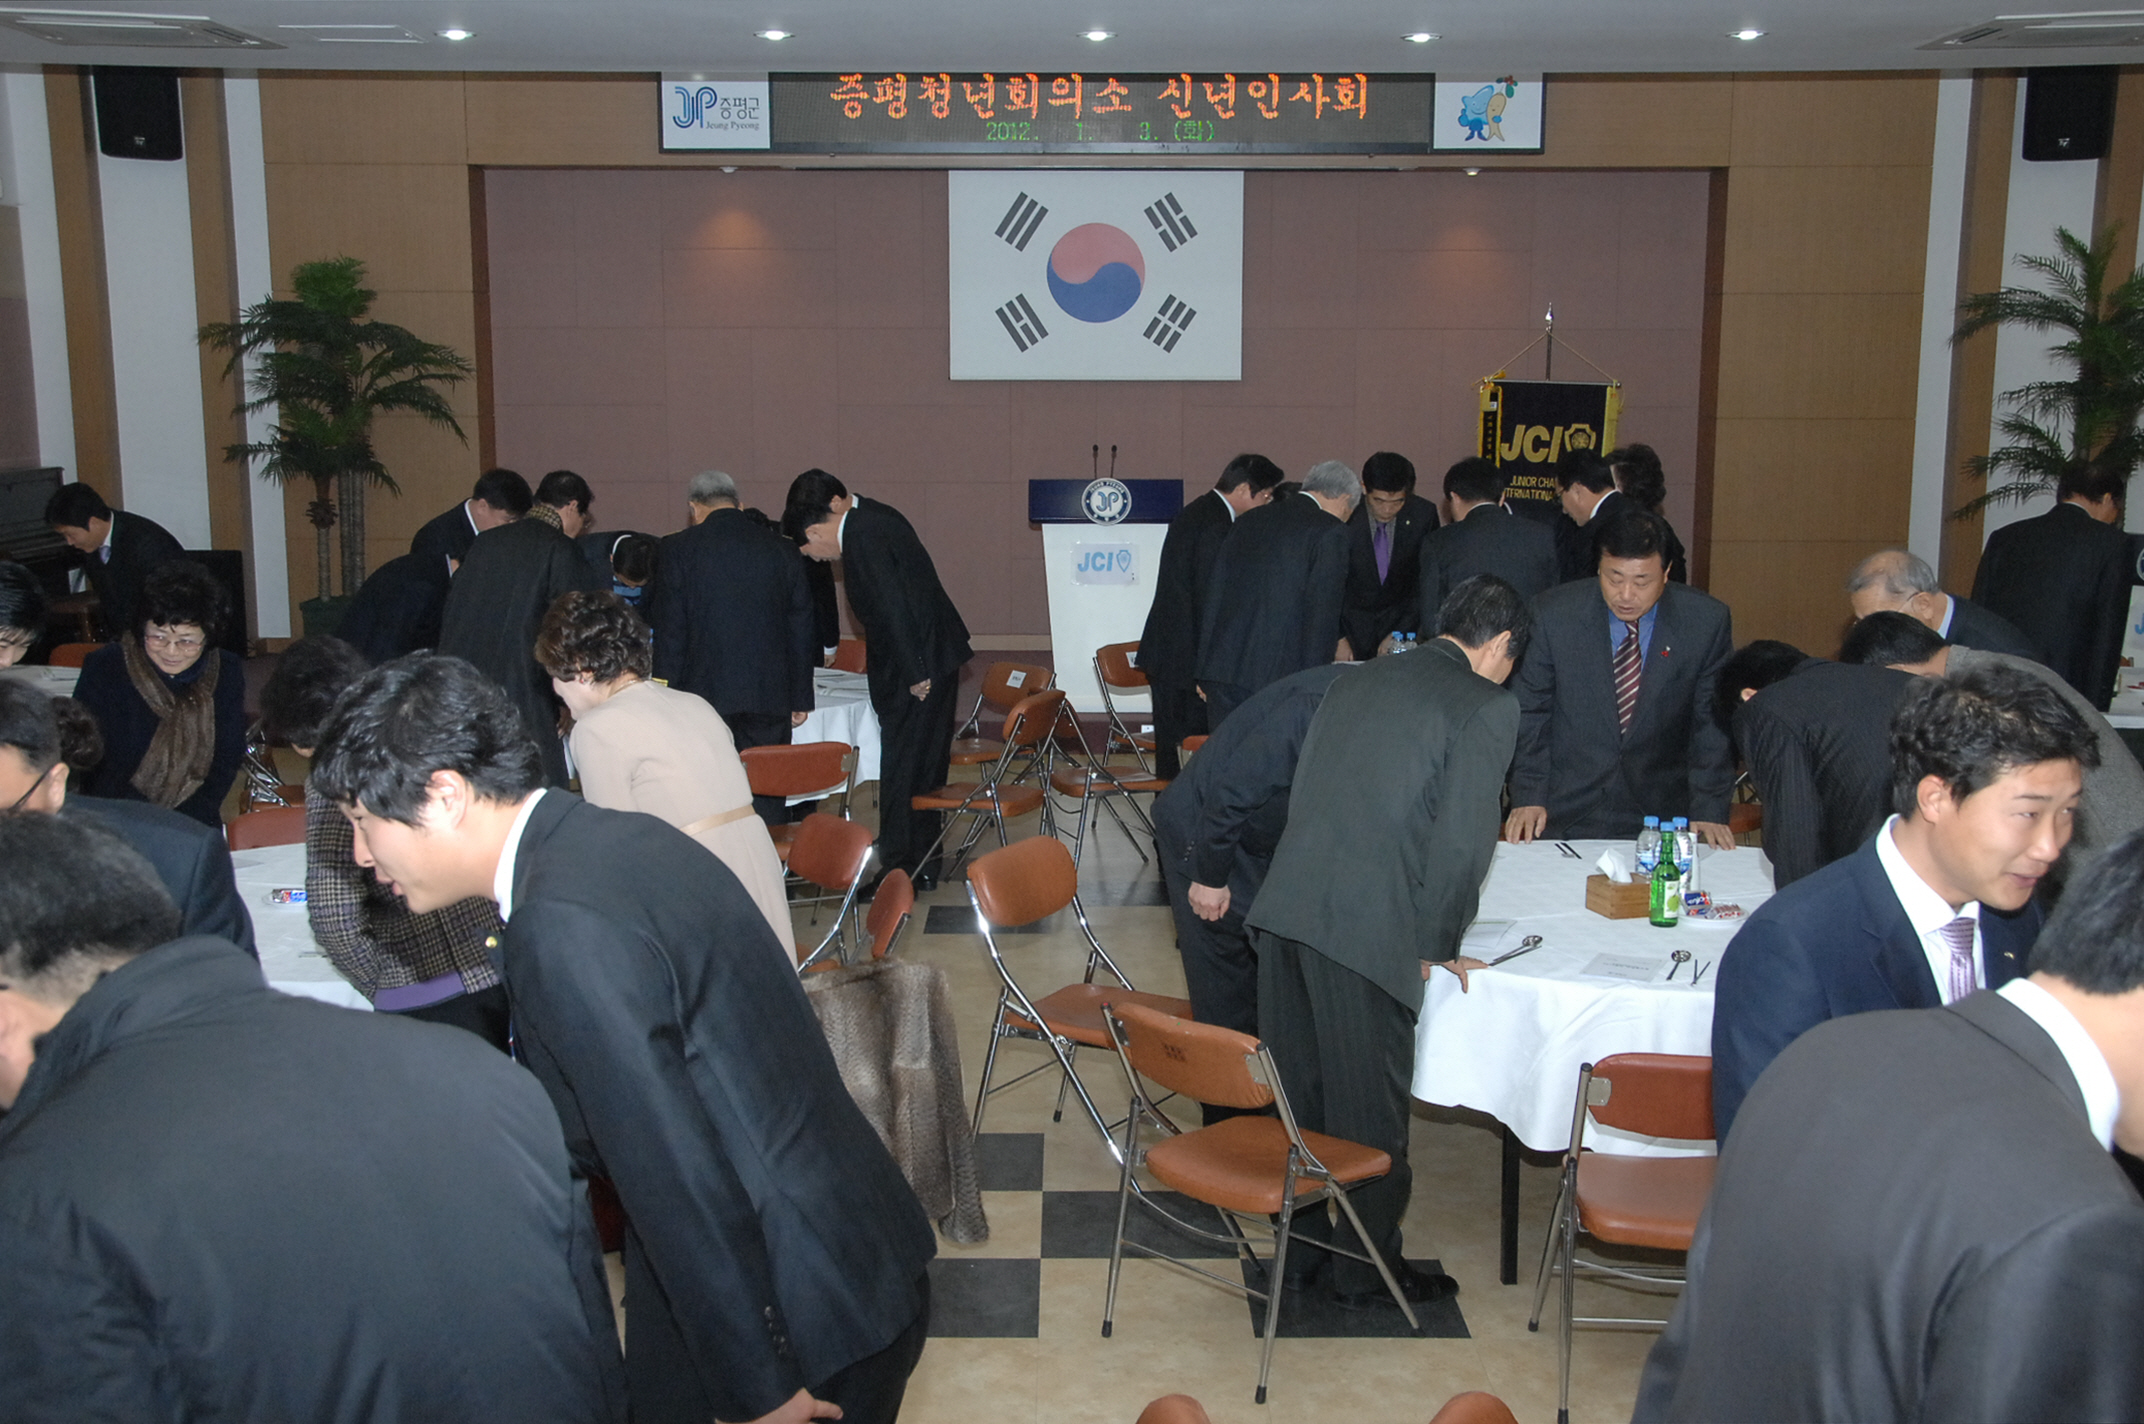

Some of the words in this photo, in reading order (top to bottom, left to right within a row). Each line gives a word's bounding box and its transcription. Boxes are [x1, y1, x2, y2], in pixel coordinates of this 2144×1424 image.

[830, 73, 1132, 119] 증평청년회의소
[1158, 73, 1367, 119] 신년인사회
[720, 97, 760, 120] 증평군
[706, 121, 729, 131] Jeung
[731, 121, 760, 131] Pyeong
[986, 121, 1039, 141] 2012.
[1173, 120, 1215, 141] (화)
[1501, 424, 1564, 463] JCI
[1510, 475, 1537, 487] JUNIOR
[1077, 552, 1114, 572] JCI
